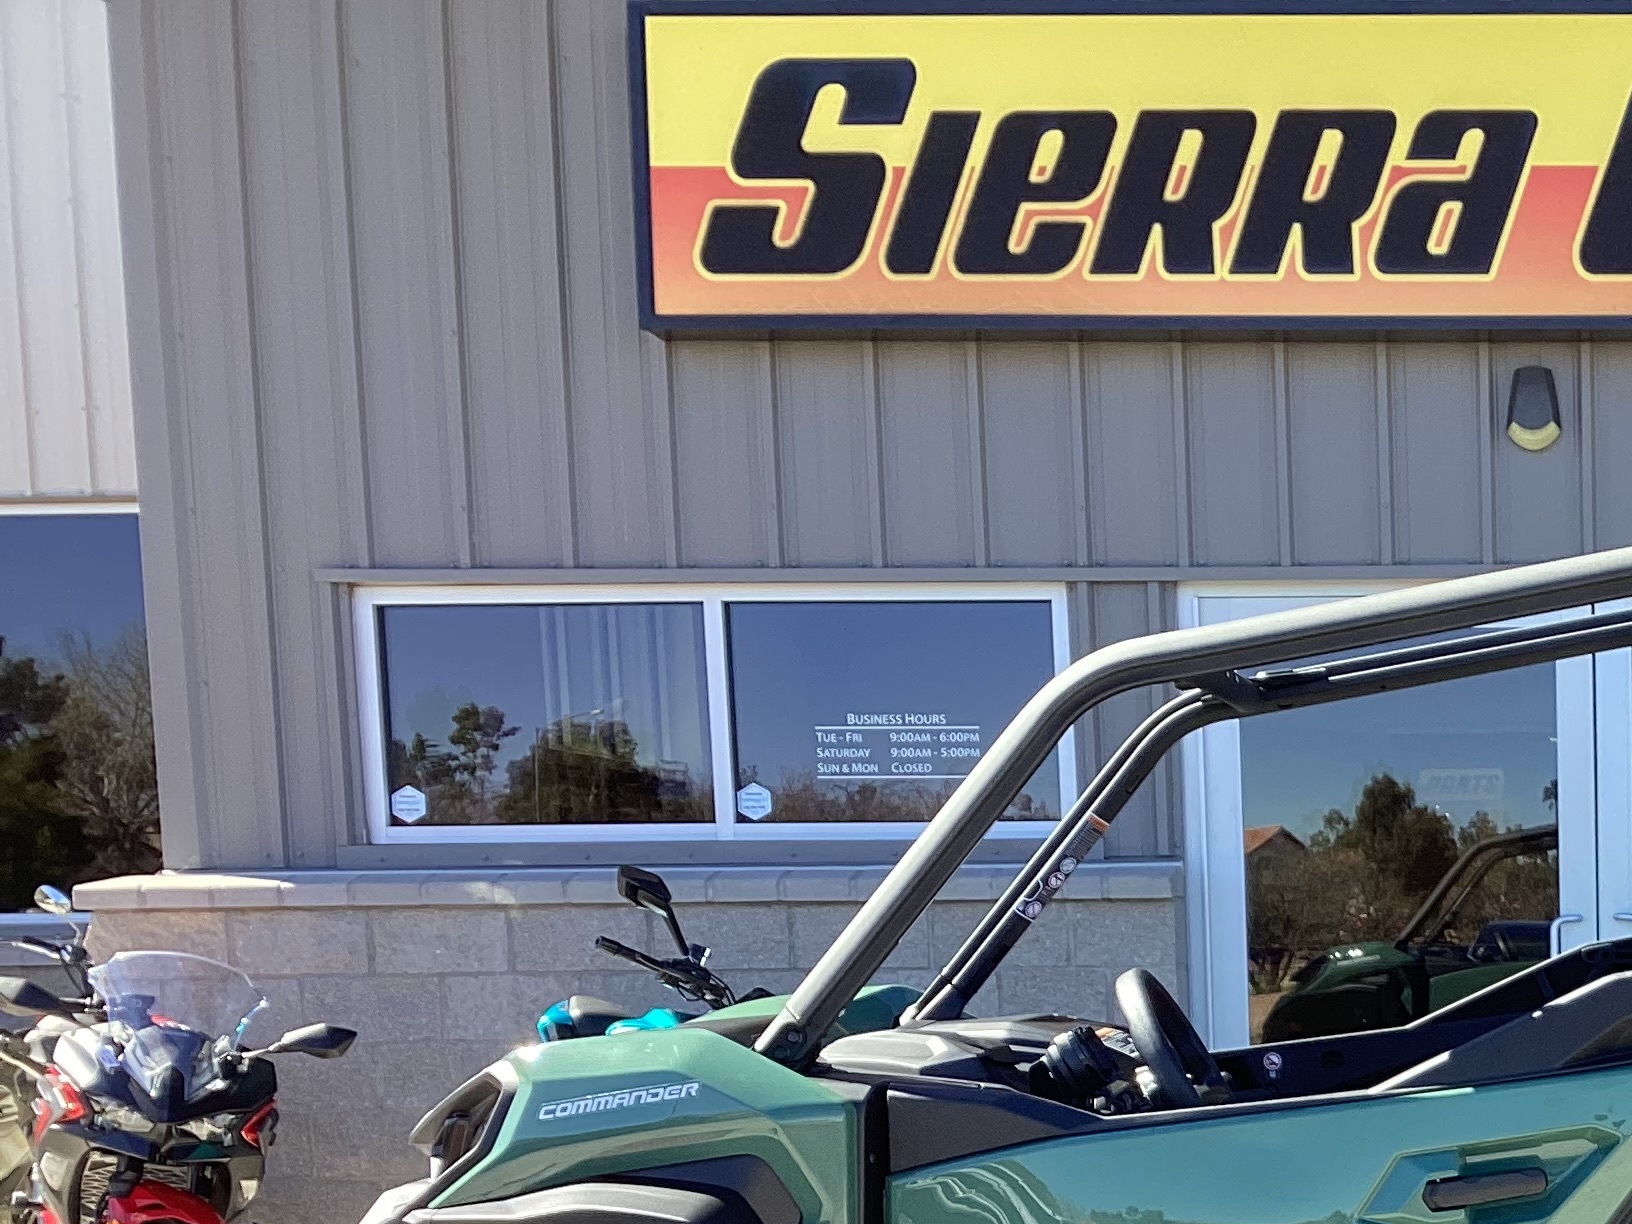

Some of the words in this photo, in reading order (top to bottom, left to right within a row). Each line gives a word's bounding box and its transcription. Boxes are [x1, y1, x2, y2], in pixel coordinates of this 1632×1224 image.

[846, 713, 902, 725] BUSINESS
[905, 713, 947, 725] HOURS
[815, 732, 837, 743] TUE
[845, 732, 863, 743] FRI
[889, 732, 931, 743] 9:00AM
[939, 732, 980, 743] 6:00PM
[816, 747, 871, 758] SATURDAY
[890, 748, 932, 758] 9:00AM
[940, 748, 981, 758] 5:00PM
[817, 763, 840, 774] SUN
[841, 763, 850, 773] &
[851, 763, 879, 773] MON
[891, 763, 932, 773] CLOSED
[538, 1082, 700, 1121] COMMANDER
